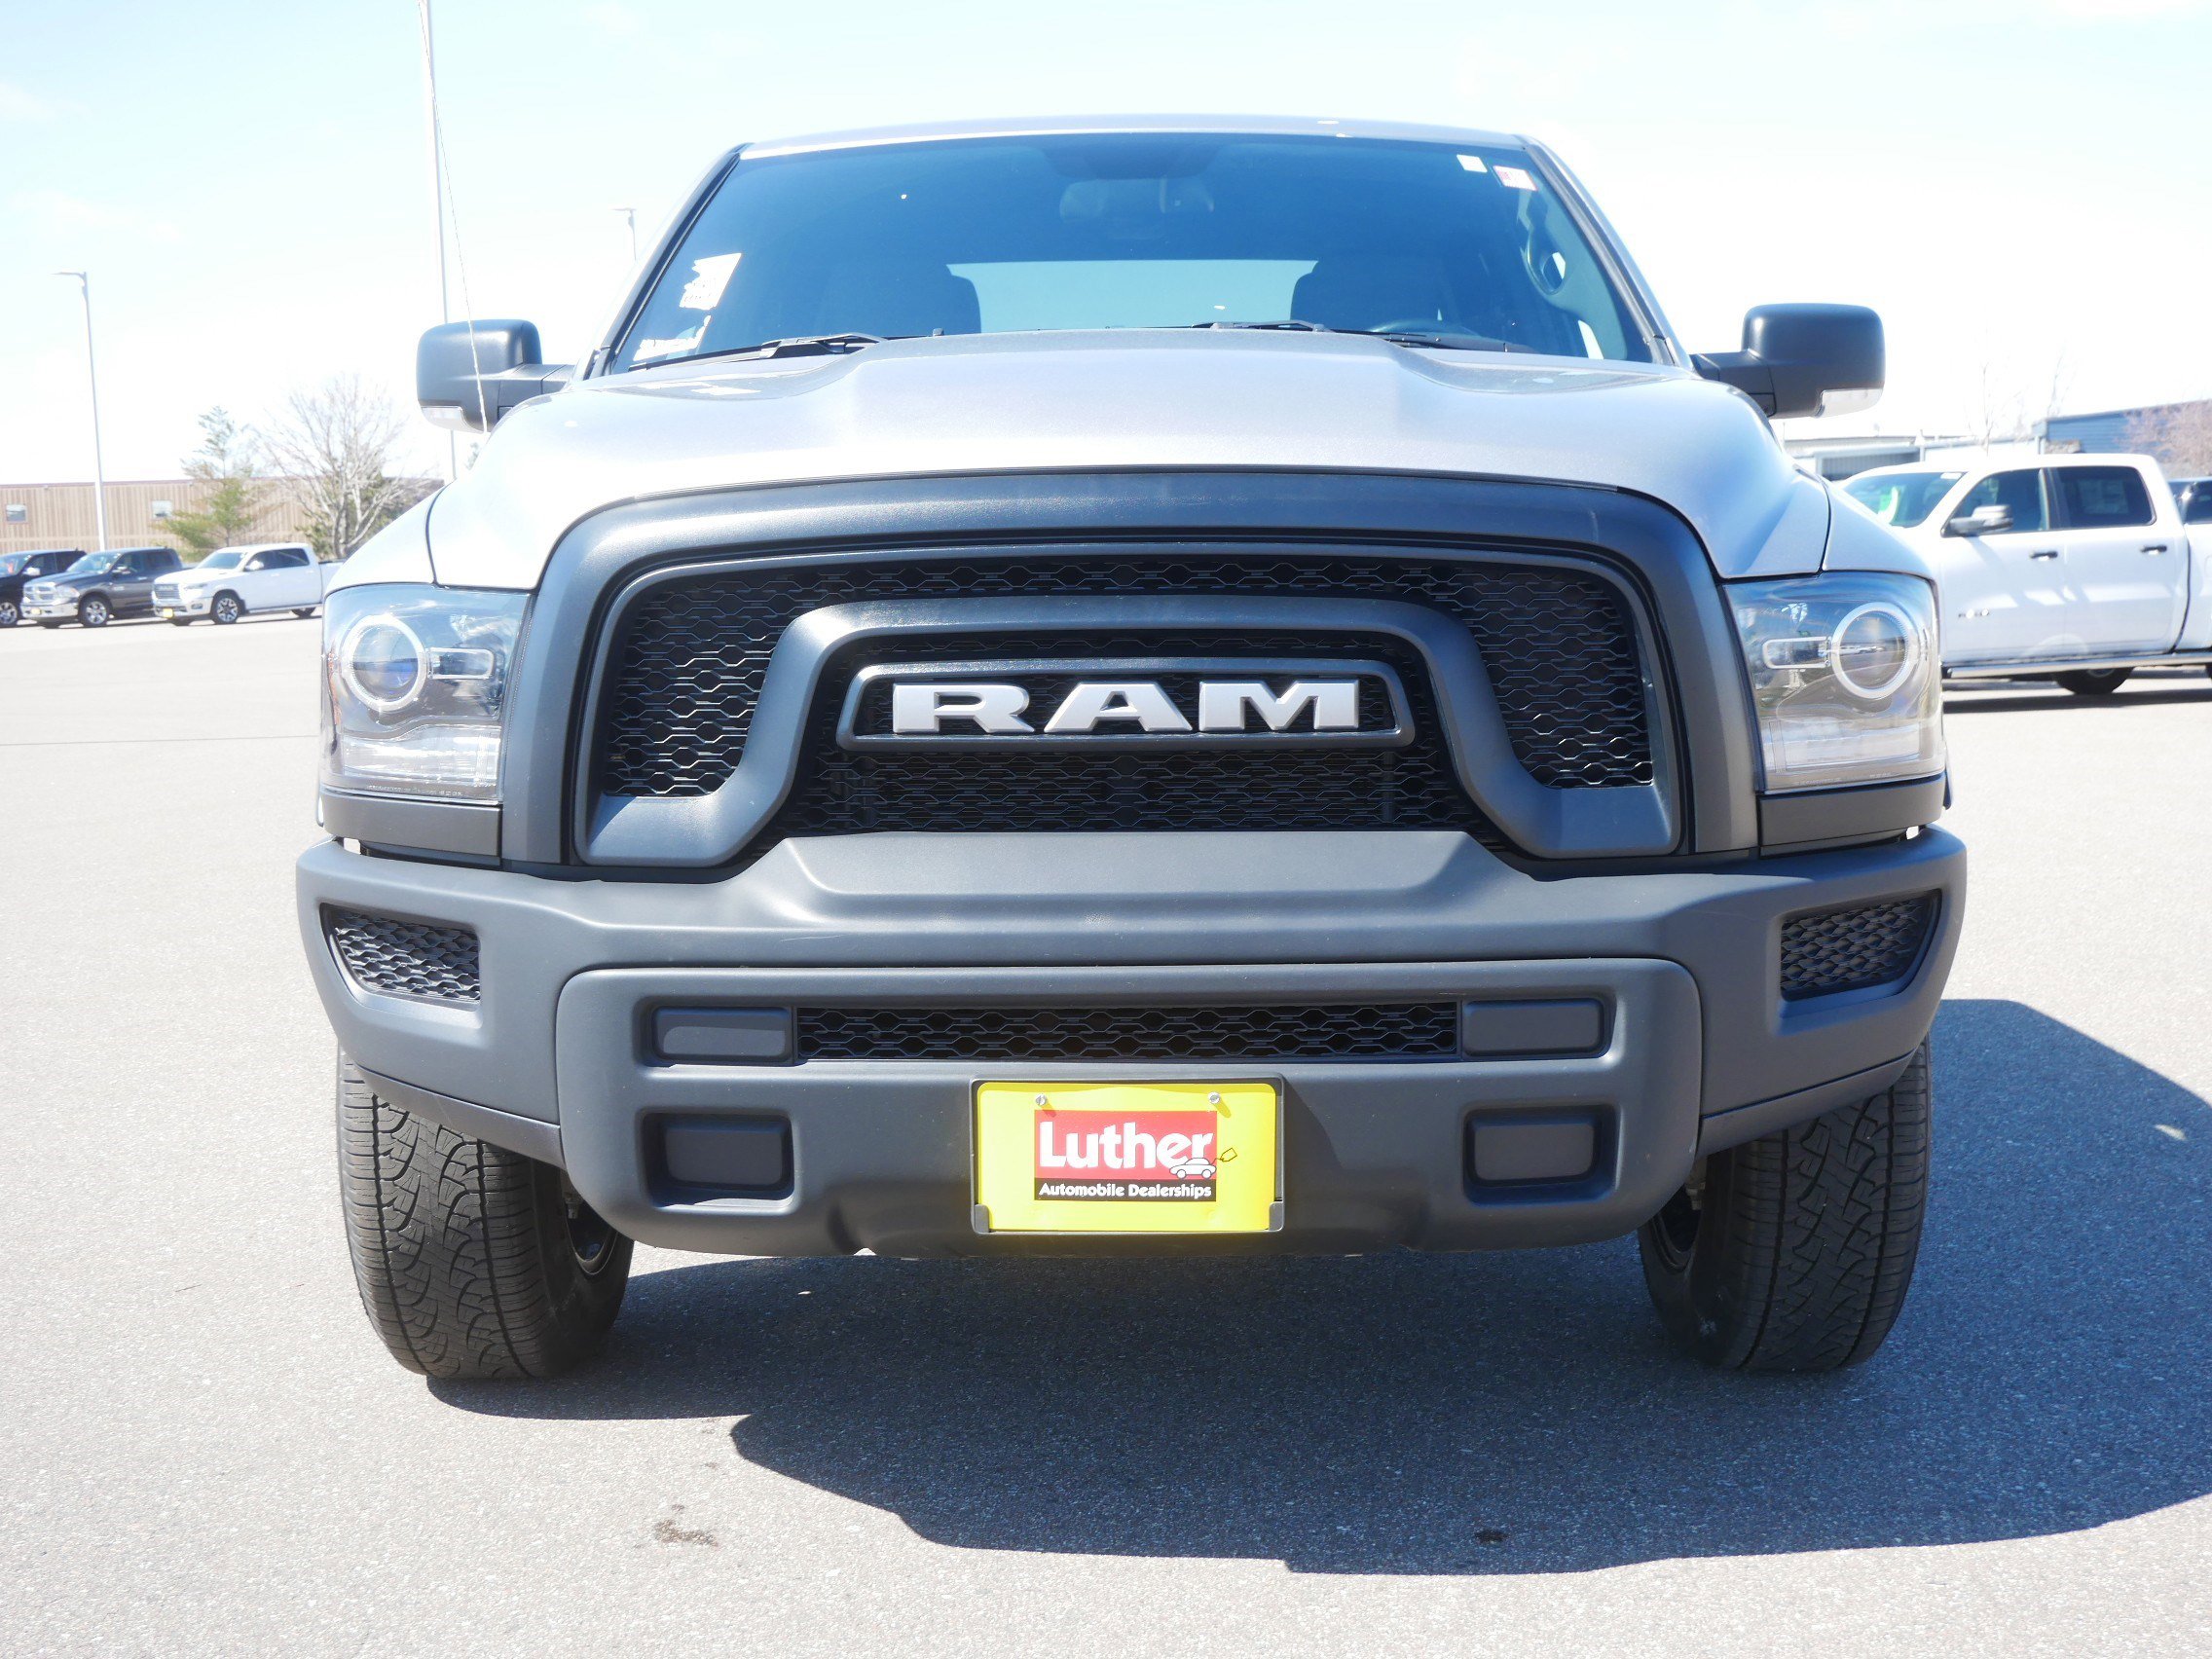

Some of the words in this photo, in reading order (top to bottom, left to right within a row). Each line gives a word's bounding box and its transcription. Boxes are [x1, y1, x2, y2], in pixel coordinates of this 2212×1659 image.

[893, 680, 1359, 733] RAM
[1039, 1121, 1214, 1170] Luther
[1039, 1183, 1124, 1198] Automobile
[1127, 1183, 1212, 1199] Dealerships
